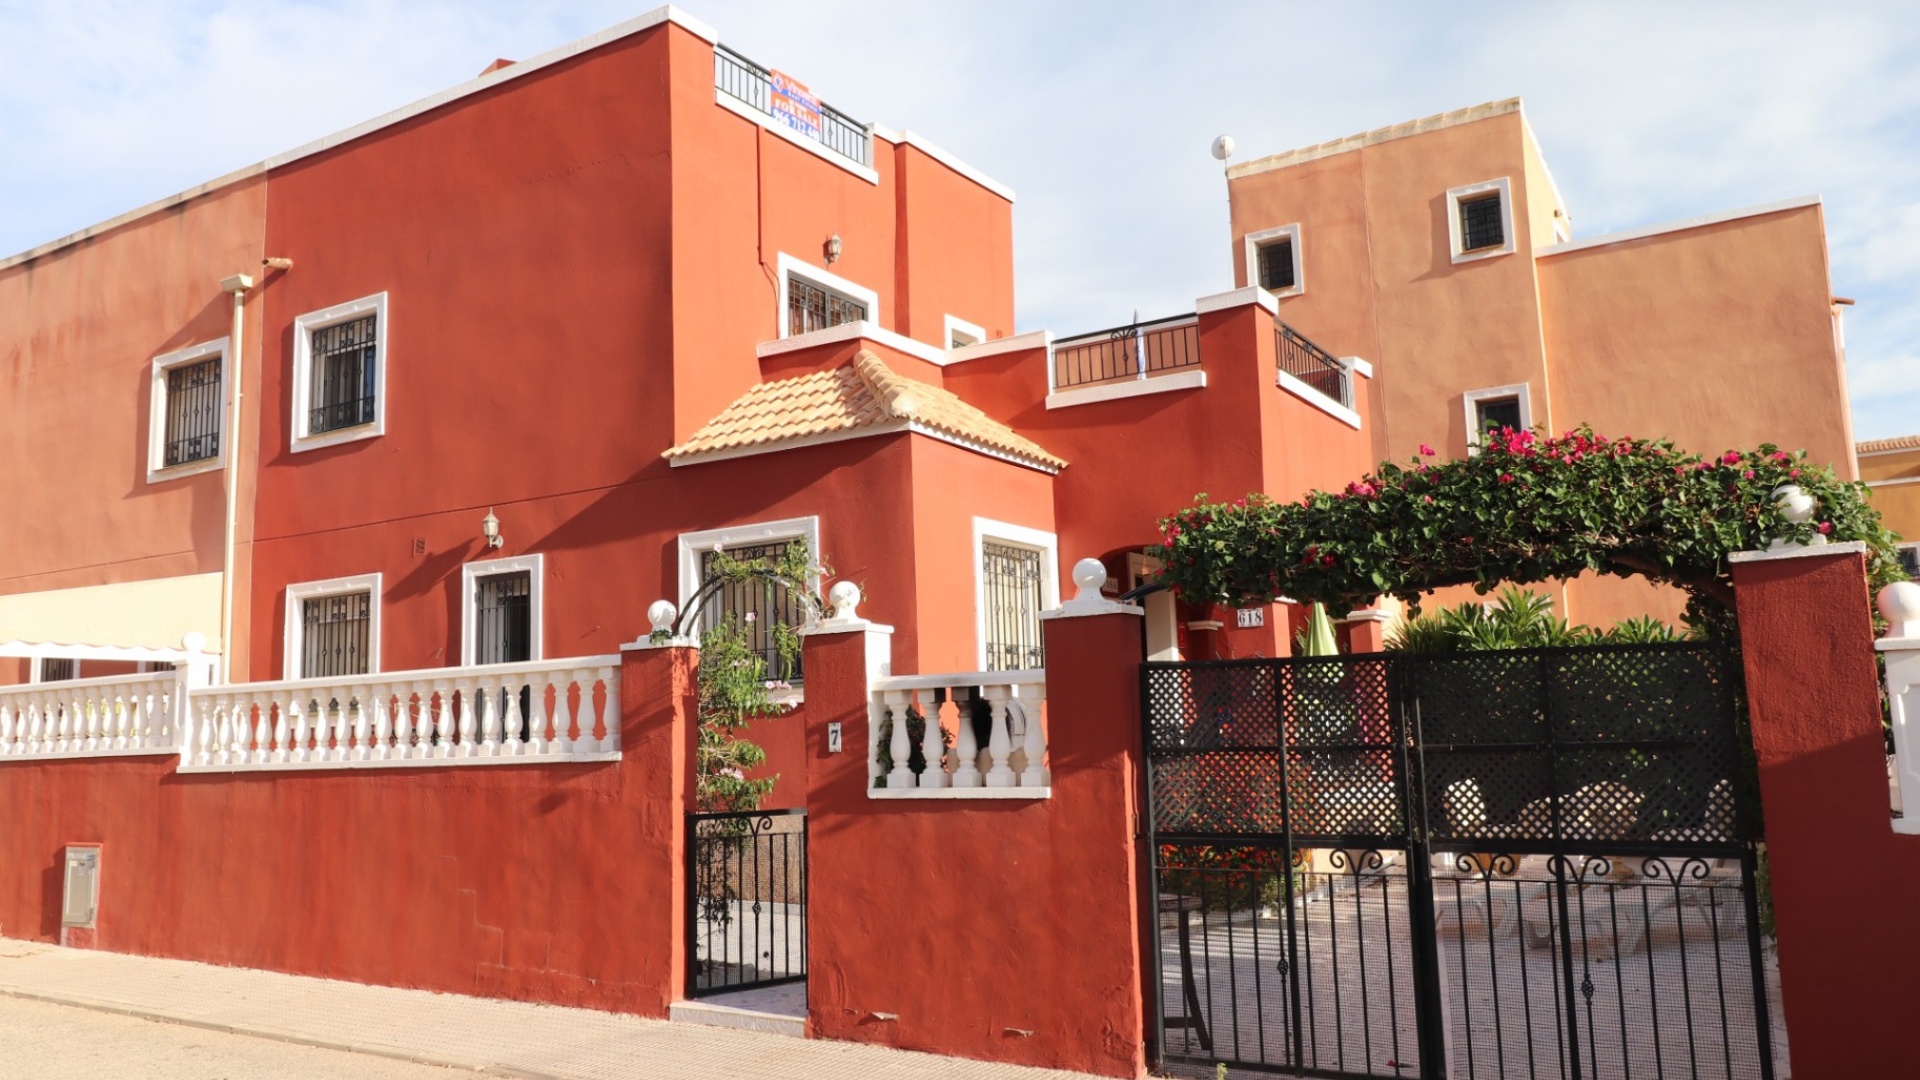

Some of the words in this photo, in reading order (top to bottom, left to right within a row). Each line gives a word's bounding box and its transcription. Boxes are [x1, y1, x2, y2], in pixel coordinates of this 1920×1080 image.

[775, 98, 795, 115] FOR
[797, 108, 818, 129] SALE
[791, 115, 806, 134] 712
[1239, 612, 1262, 624] 618
[831, 730, 838, 745] 7
